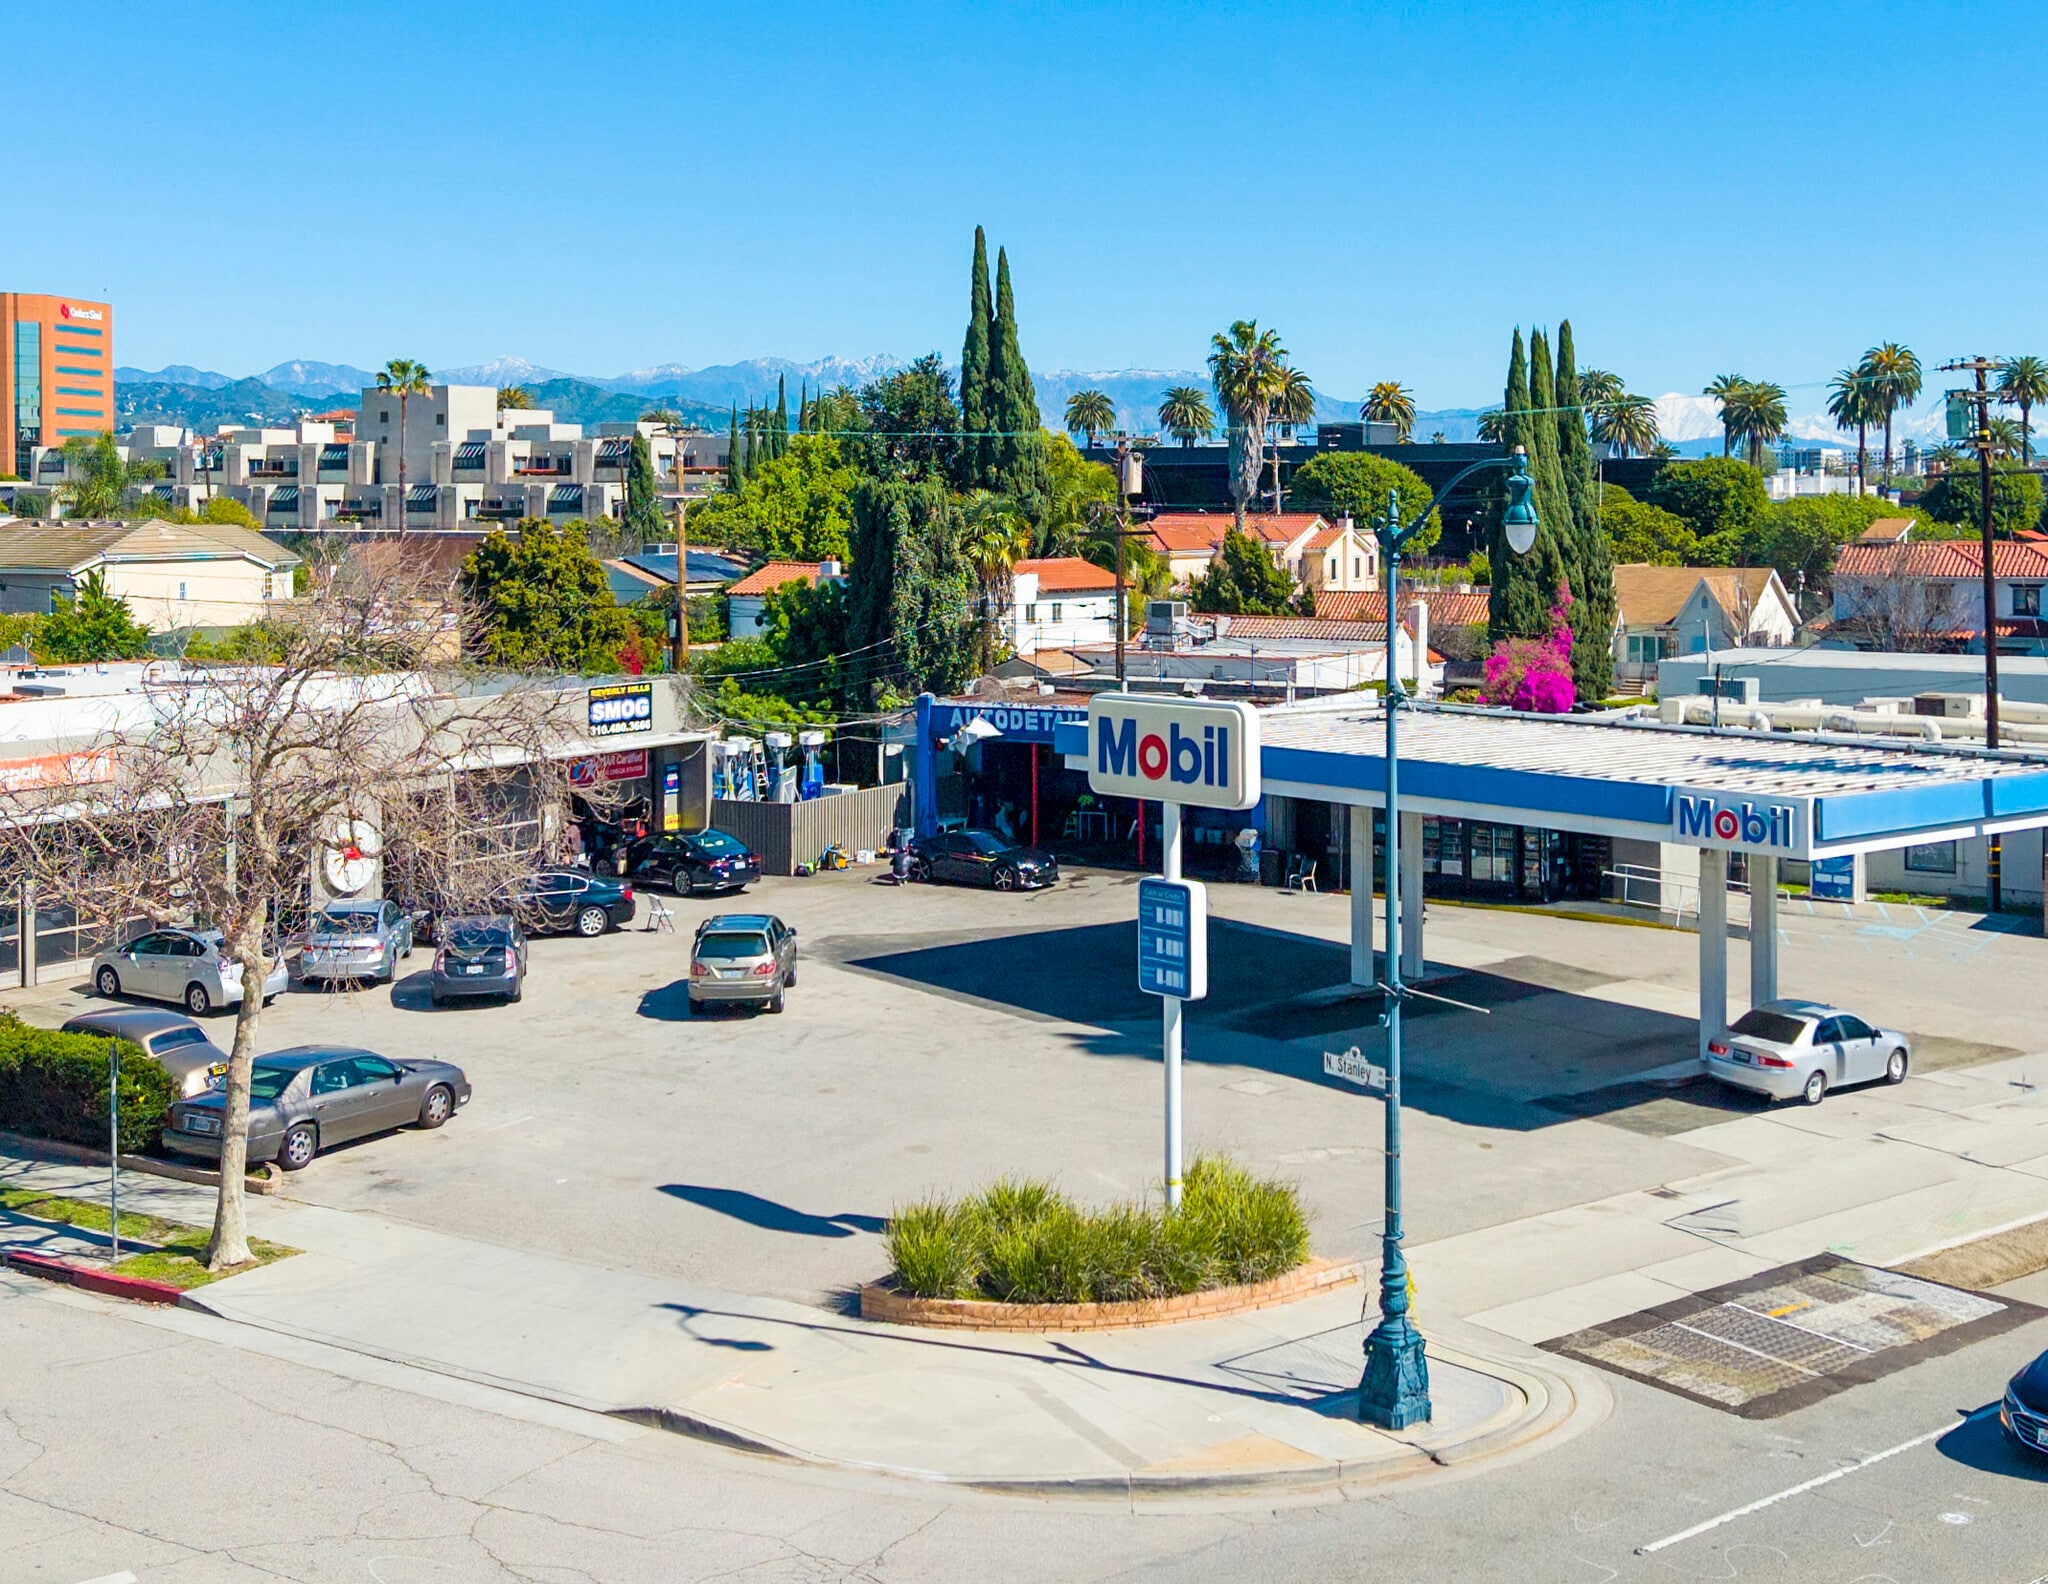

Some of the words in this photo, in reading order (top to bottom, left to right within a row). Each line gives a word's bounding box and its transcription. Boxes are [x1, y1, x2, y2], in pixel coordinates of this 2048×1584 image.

[591, 697, 650, 722] SMOG
[1098, 716, 1229, 787] Mobil
[1679, 796, 1794, 849] Mobil
[1326, 1054, 1335, 1071] N.
[1337, 1057, 1371, 1085] Stanley
